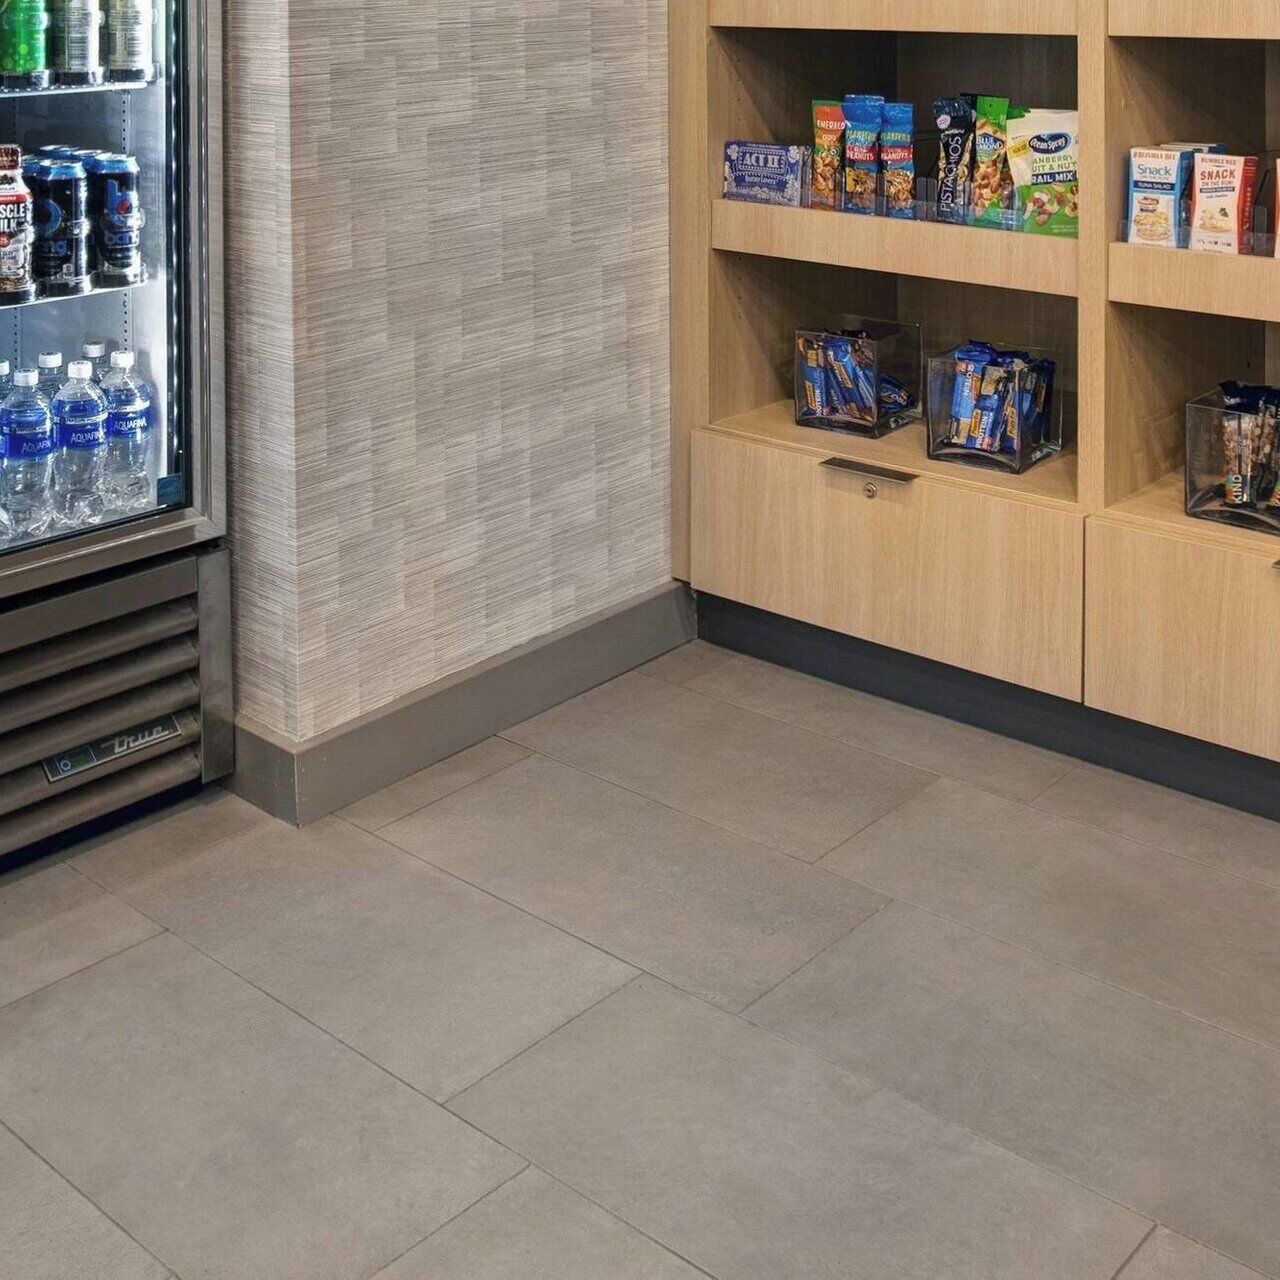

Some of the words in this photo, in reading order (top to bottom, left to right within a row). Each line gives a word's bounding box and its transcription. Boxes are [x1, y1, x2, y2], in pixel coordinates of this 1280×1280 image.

[816, 120, 846, 130] EMERALD
[743, 152, 765, 166] ACT
[767, 154, 780, 168] II
[846, 151, 874, 161] PEANUTS
[881, 151, 909, 160] PEANUTS
[940, 135, 962, 211] PISTACHIOS
[1138, 164, 1171, 176] Snack
[1200, 169, 1236, 181] SNACK
[1232, 474, 1243, 504] KIND
